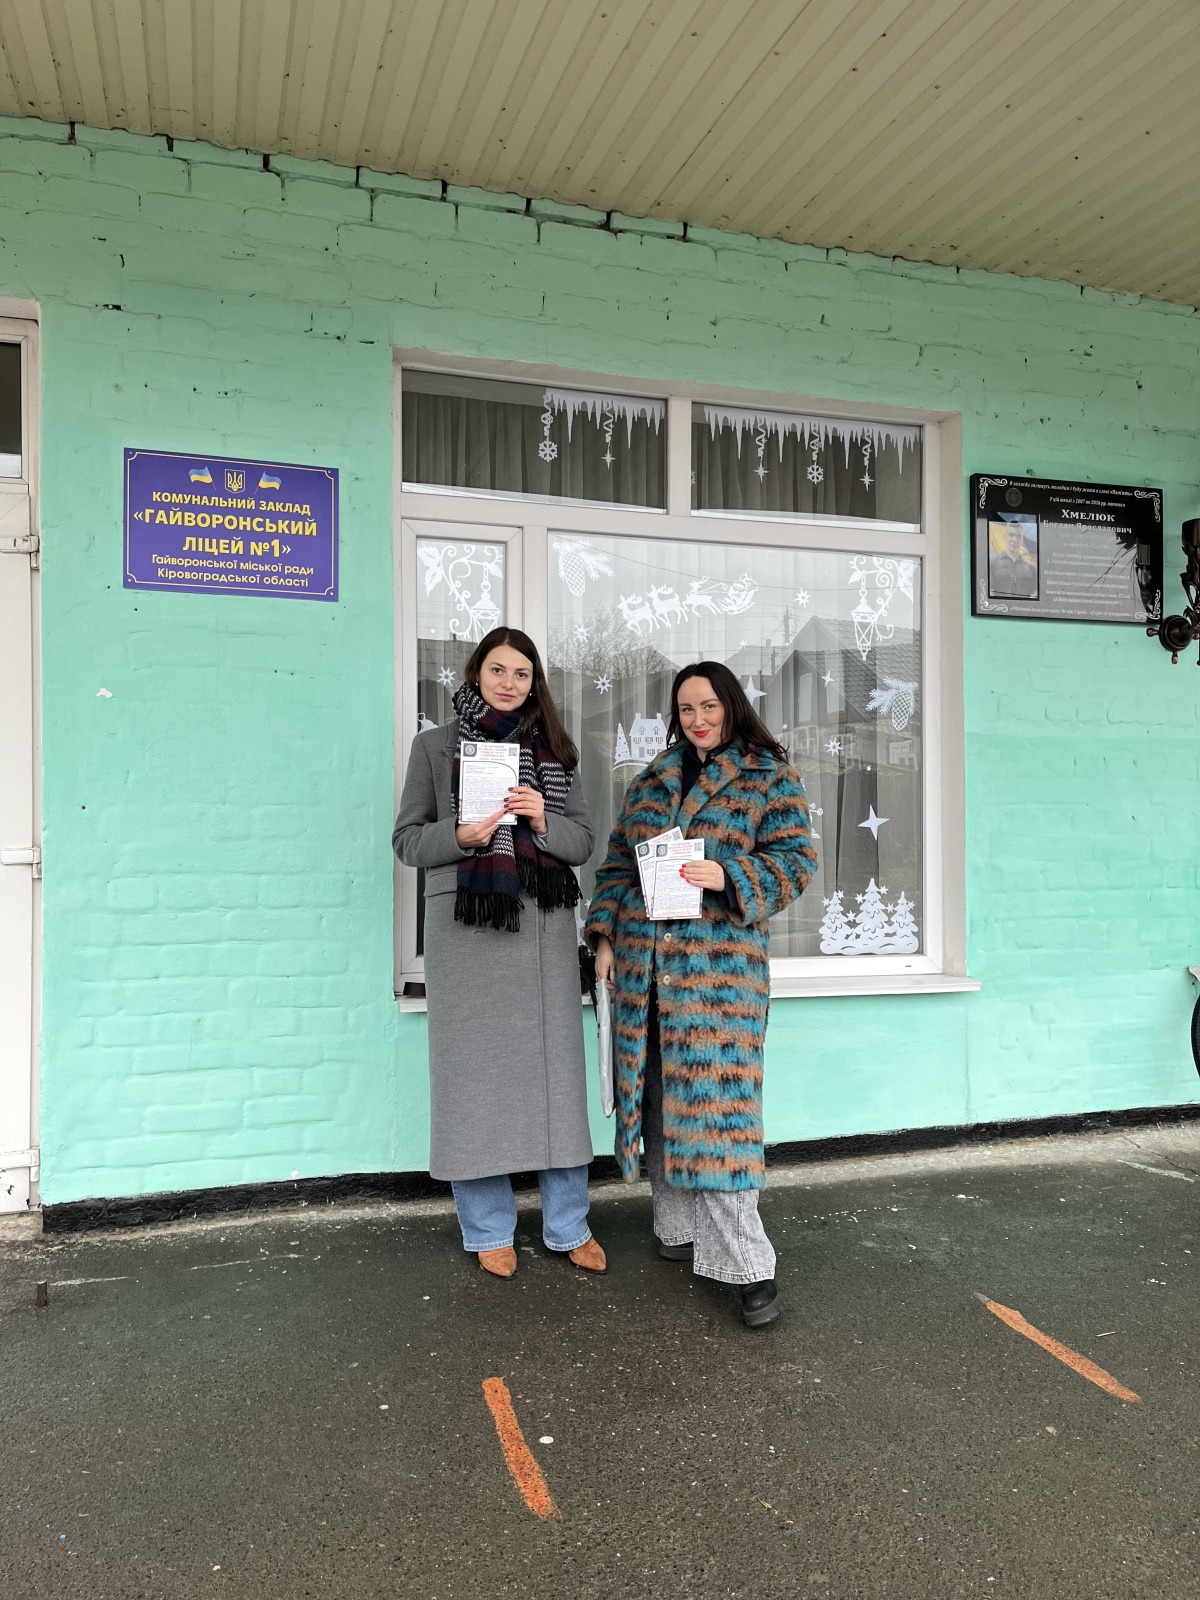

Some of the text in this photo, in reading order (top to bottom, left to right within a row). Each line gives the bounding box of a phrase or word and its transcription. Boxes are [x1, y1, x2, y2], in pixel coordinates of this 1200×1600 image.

[152, 491, 311, 516] КОМУНАЛЬНИЙ ЗАКЛАД
[133, 506, 317, 537] «ГАЙВОРОНСЬКИЙ
[1043, 519, 1132, 534] Богдан Ярославович
[182, 536, 291, 558] ЛІЦЕЙ №1»
[152, 554, 314, 576] Гайворонської міської ради
[157, 567, 309, 587] Кіровоградської області
